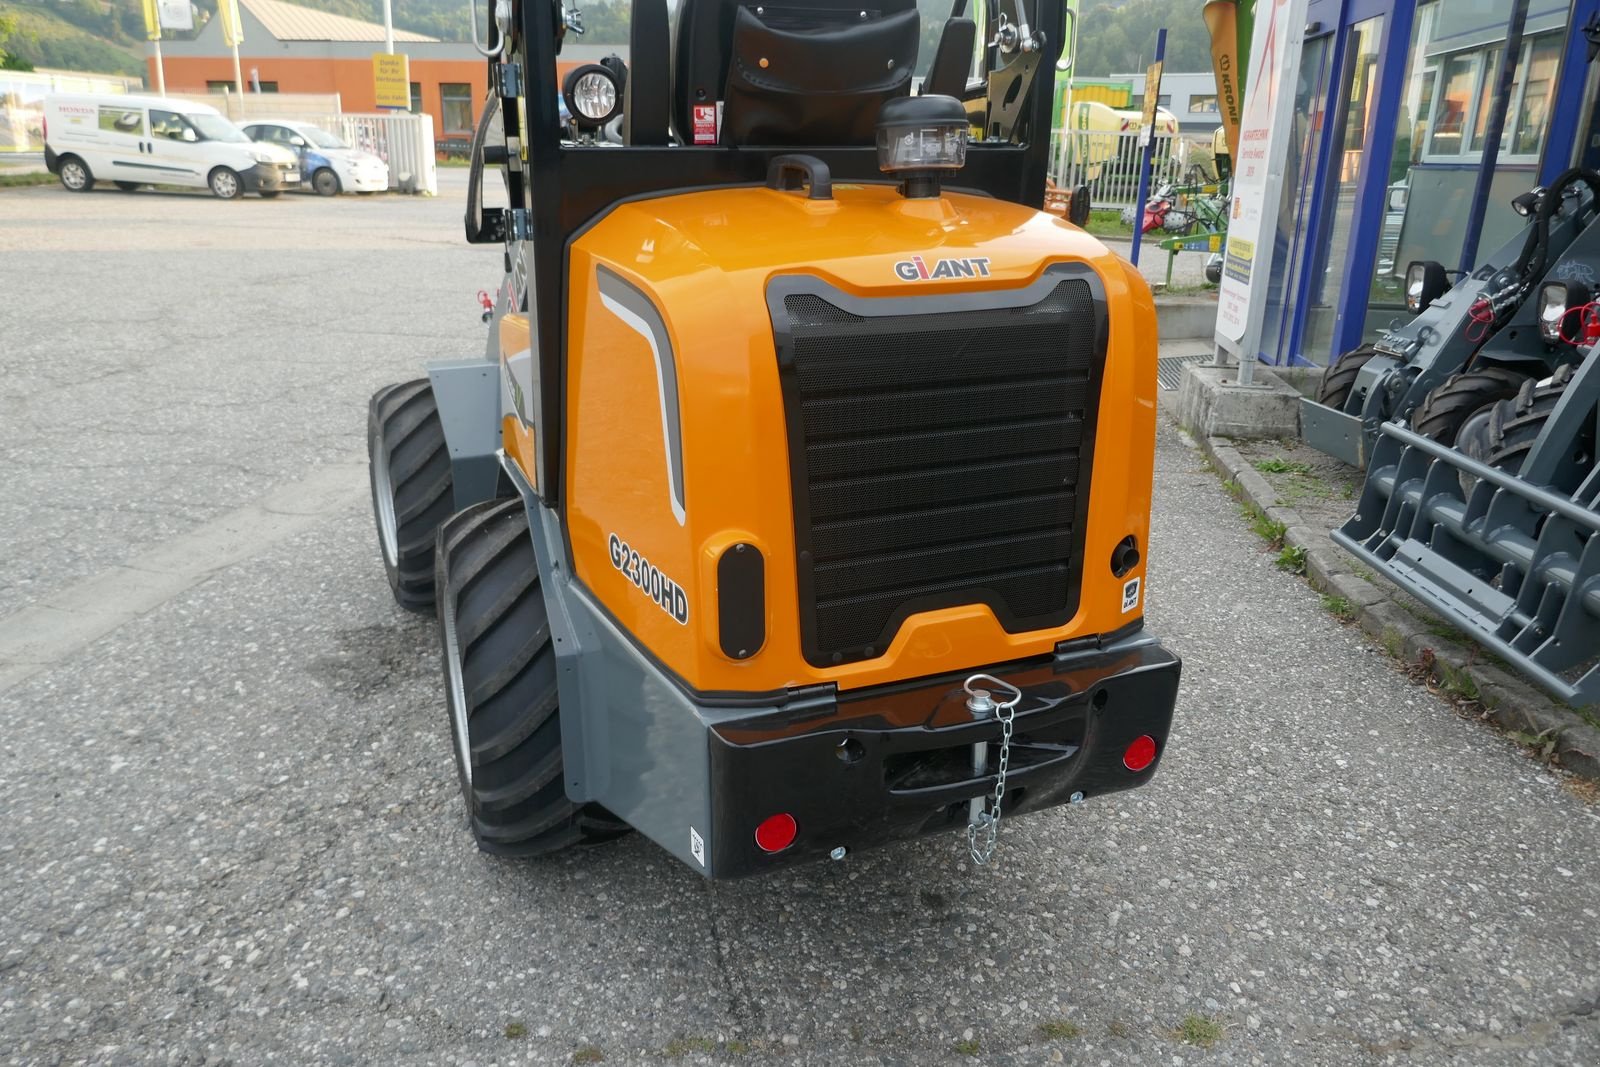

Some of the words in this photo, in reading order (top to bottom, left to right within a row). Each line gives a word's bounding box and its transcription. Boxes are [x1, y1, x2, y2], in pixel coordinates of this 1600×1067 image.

[58, 105, 95, 114] HONDA
[1222, 73, 1239, 126] KRONE
[608, 532, 689, 626] G2300HD
